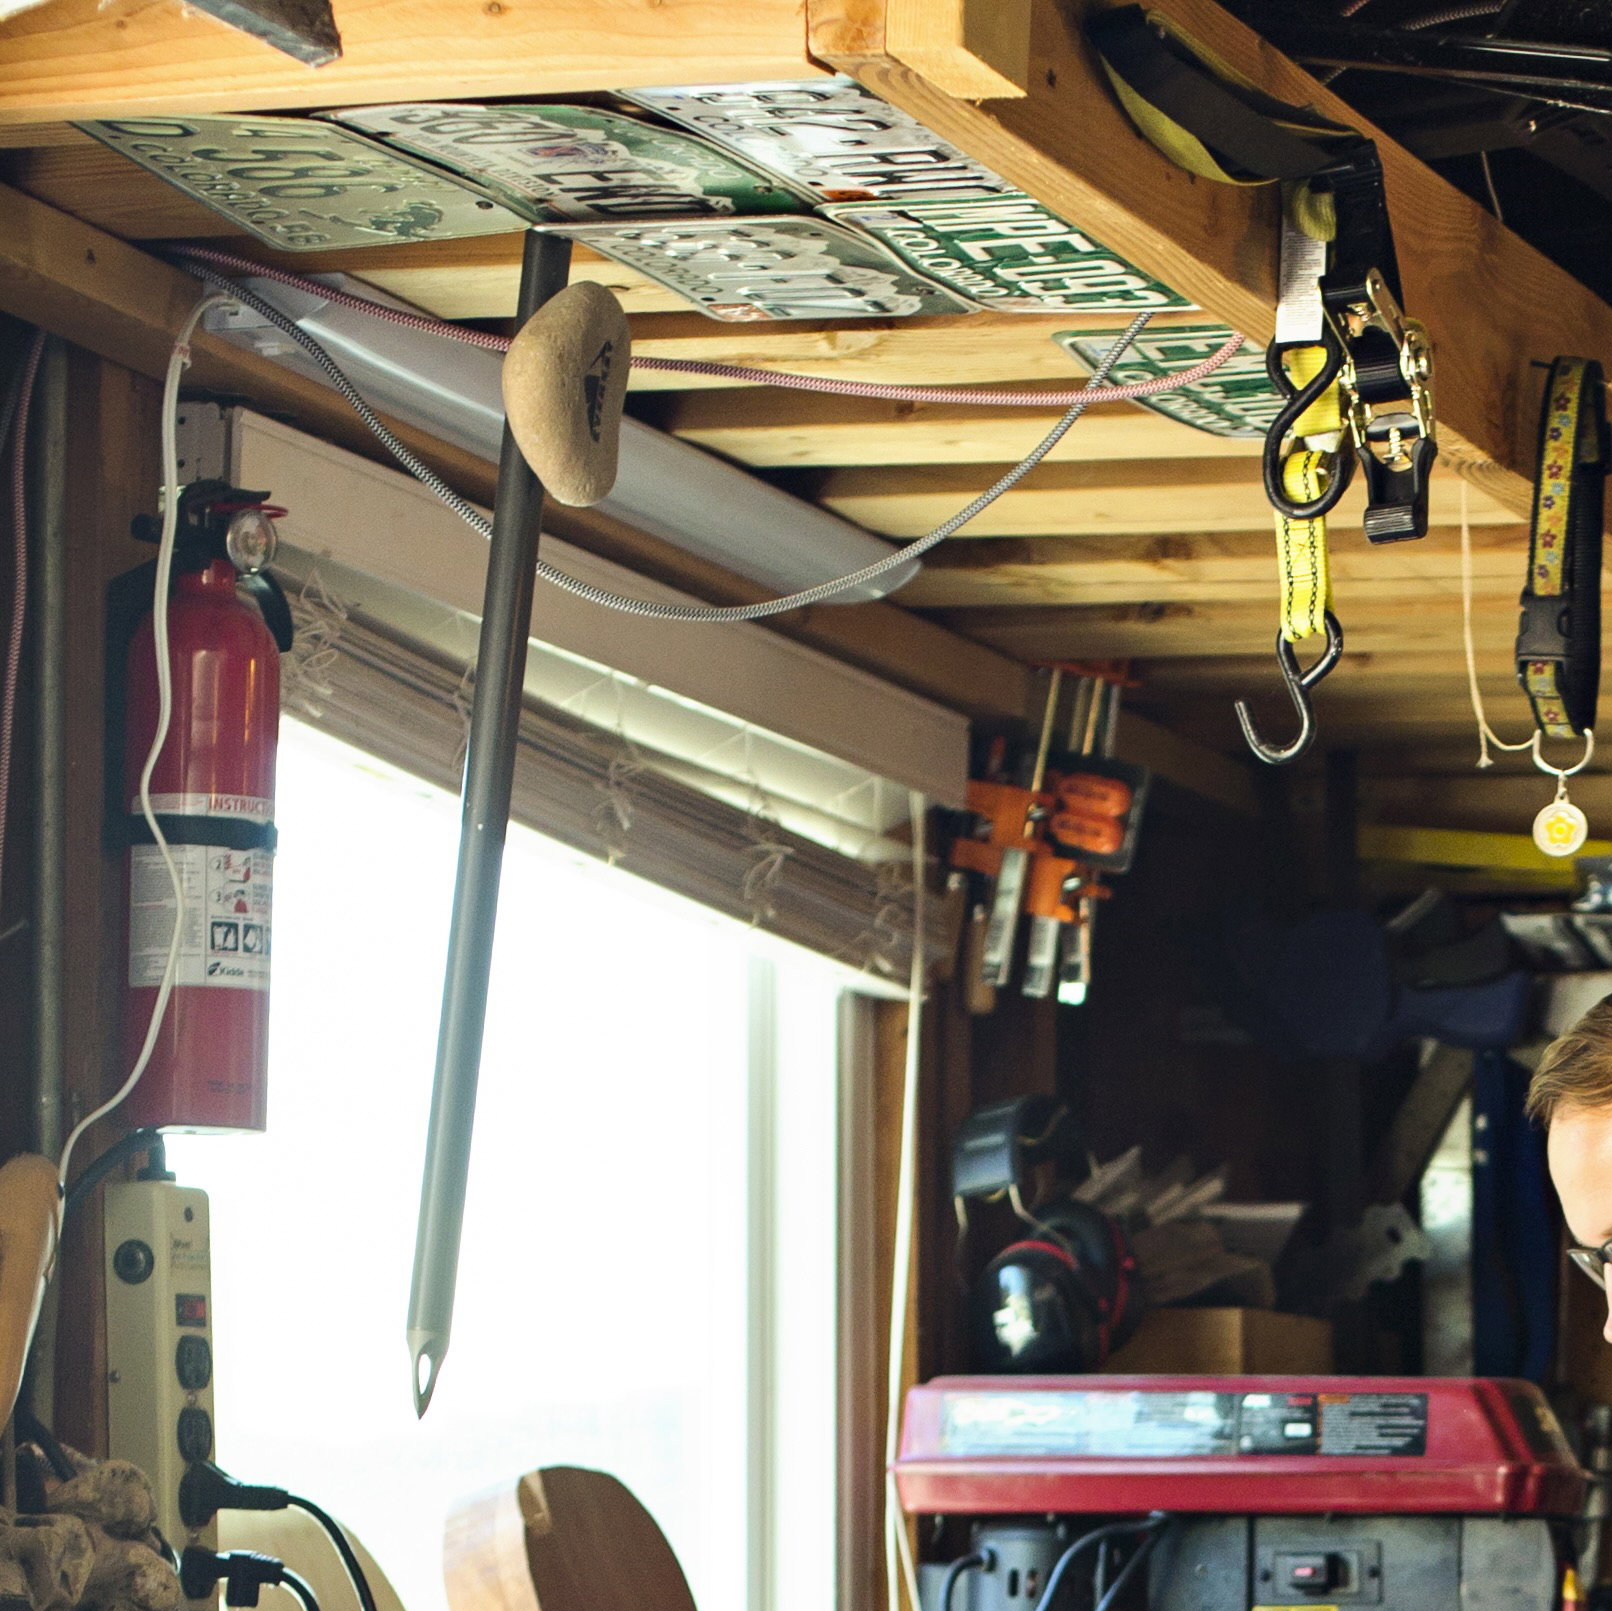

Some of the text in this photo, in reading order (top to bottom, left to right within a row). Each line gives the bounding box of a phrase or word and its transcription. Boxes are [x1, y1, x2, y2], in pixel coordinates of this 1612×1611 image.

[131, 143, 290, 221] COLORADO
[611, 243, 725, 295] COLORADO
[886, 227, 1009, 299] COLORADO
